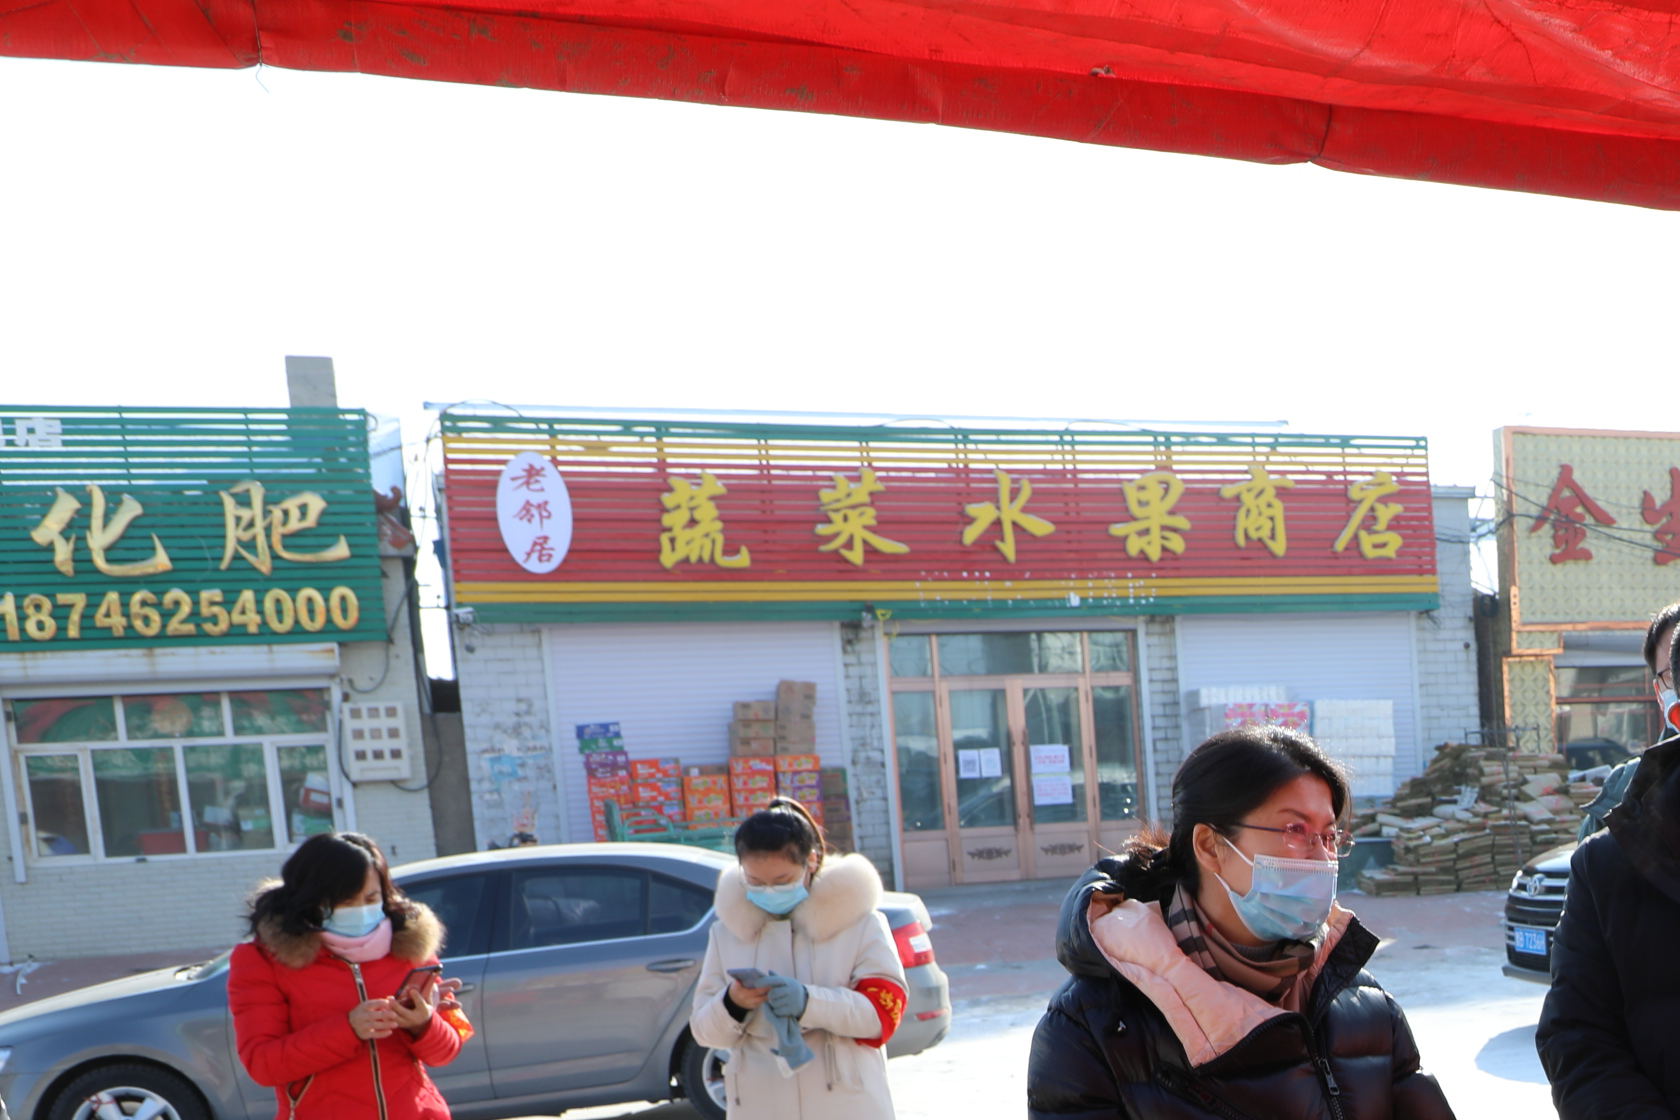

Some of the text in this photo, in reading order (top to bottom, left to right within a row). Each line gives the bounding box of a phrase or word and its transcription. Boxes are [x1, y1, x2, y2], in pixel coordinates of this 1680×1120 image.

[30, 480, 352, 577] 化肥
[509, 462, 556, 565] 老邻居
[658, 466, 1406, 571] 蔬菜水果商店
[0, 585, 360, 642] 18746254000
